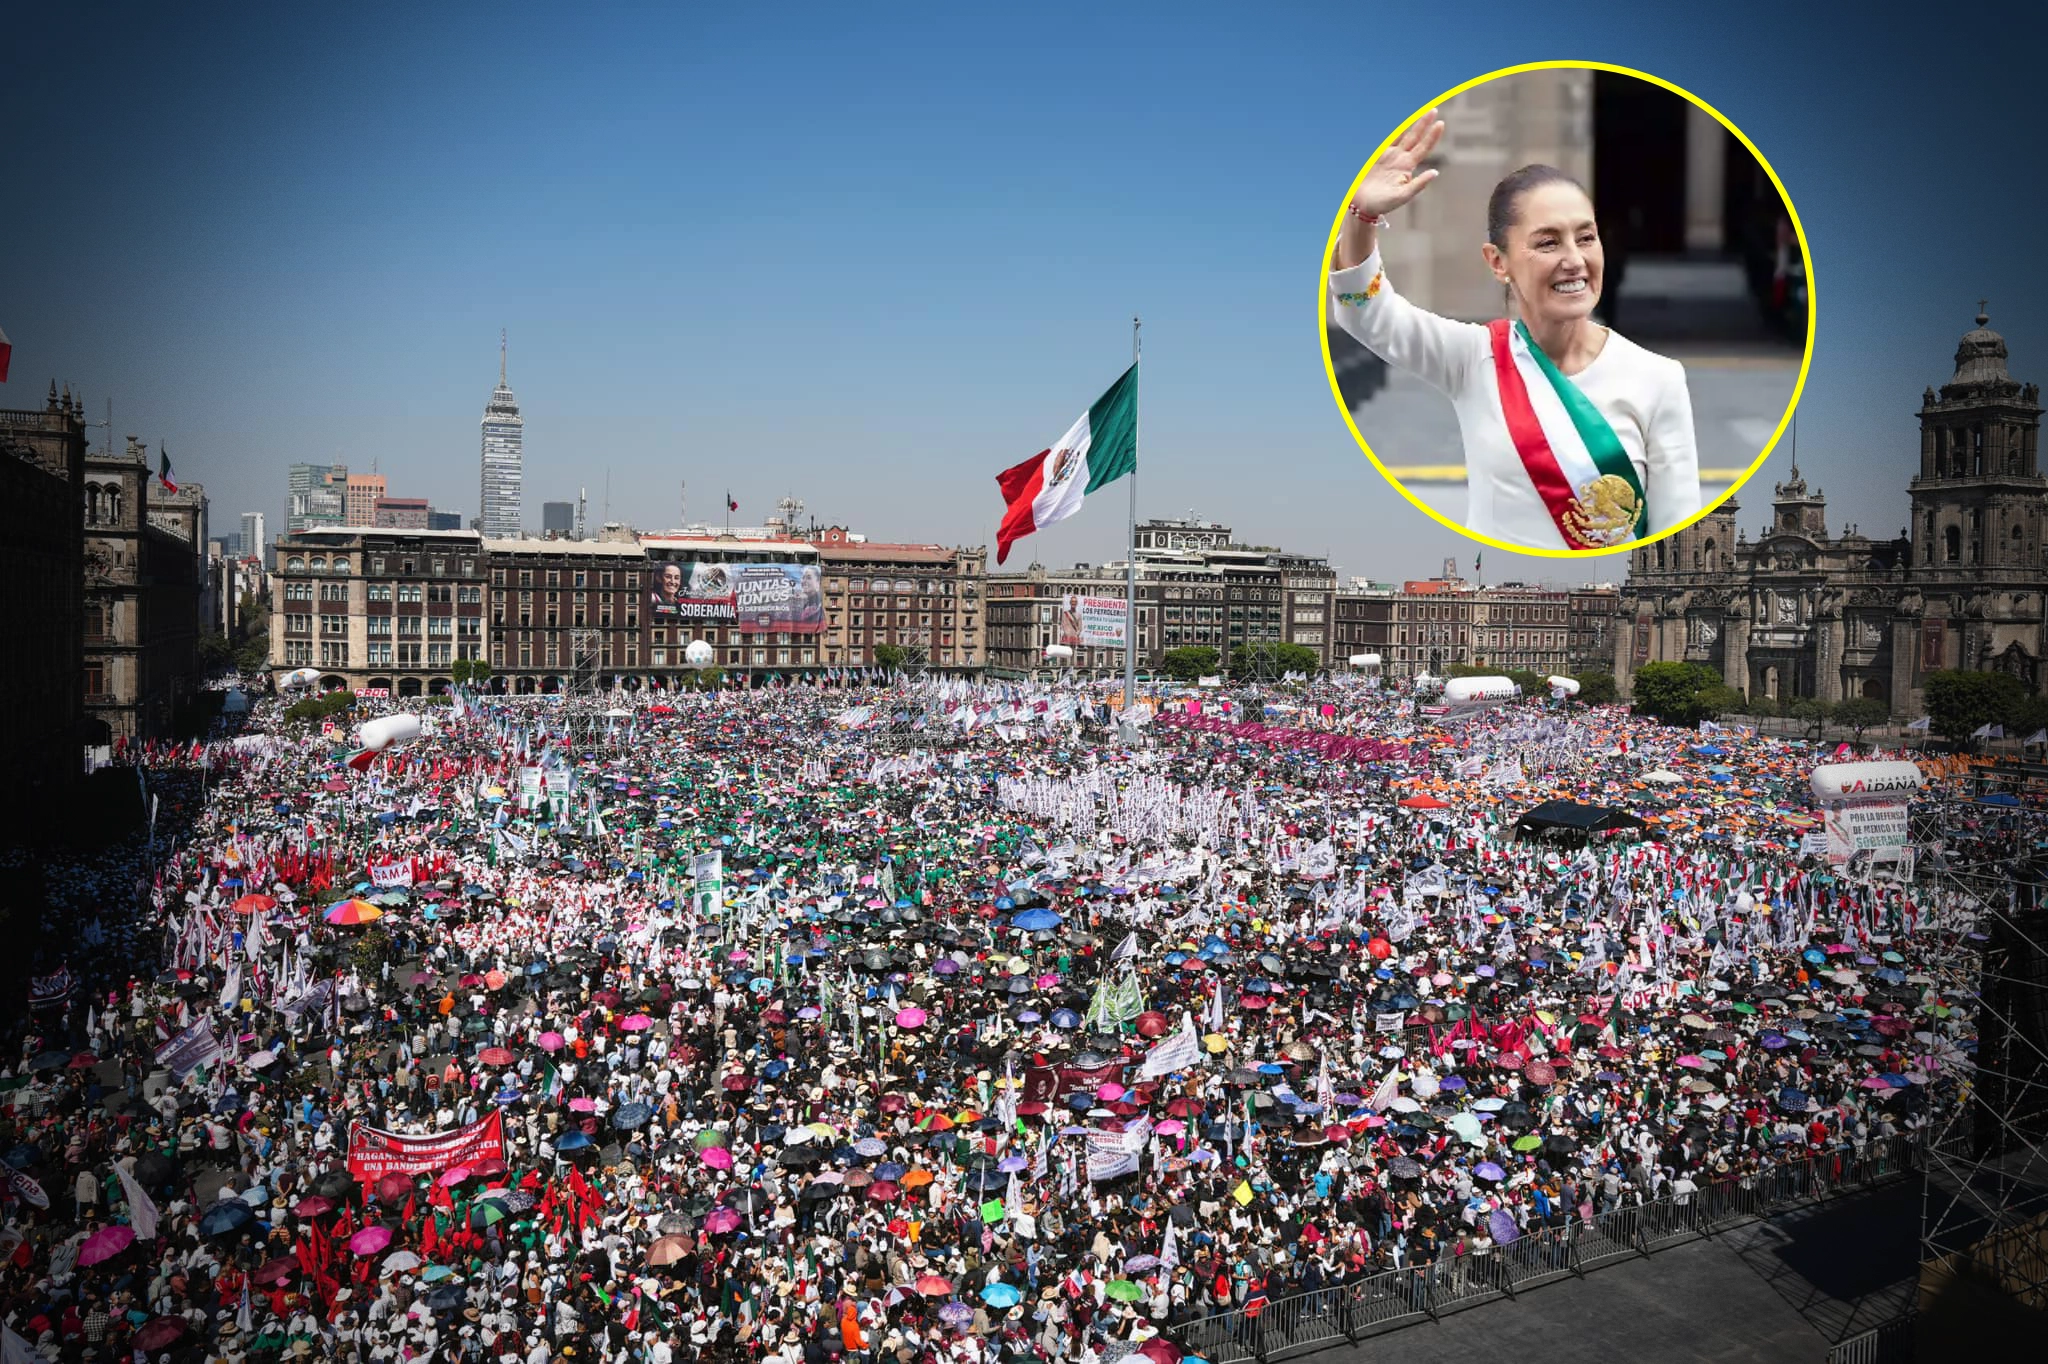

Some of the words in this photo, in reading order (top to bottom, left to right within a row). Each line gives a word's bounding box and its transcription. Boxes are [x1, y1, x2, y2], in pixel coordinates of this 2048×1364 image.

[735, 578, 790, 594] JUNTAS
[737, 590, 790, 606] JUNTOS
[1083, 598, 1127, 610] PRESIDENTA
[680, 602, 737, 619] SOBERANÍA
[1082, 607, 1093, 615] LOS
[355, 688, 389, 697] CROC
[1850, 779, 1917, 794] ALDANA
[1850, 813, 1865, 823] POR
[1866, 812, 1875, 821] LA
[1876, 811, 1905, 821] DEFENSA
[1853, 825, 1862, 835] DE
[1892, 823, 1897, 833] Y
[1897, 823, 1907, 833] SU
[364, 1162, 383, 1172] UNA
[0, 1162, 40, 1196] orena
